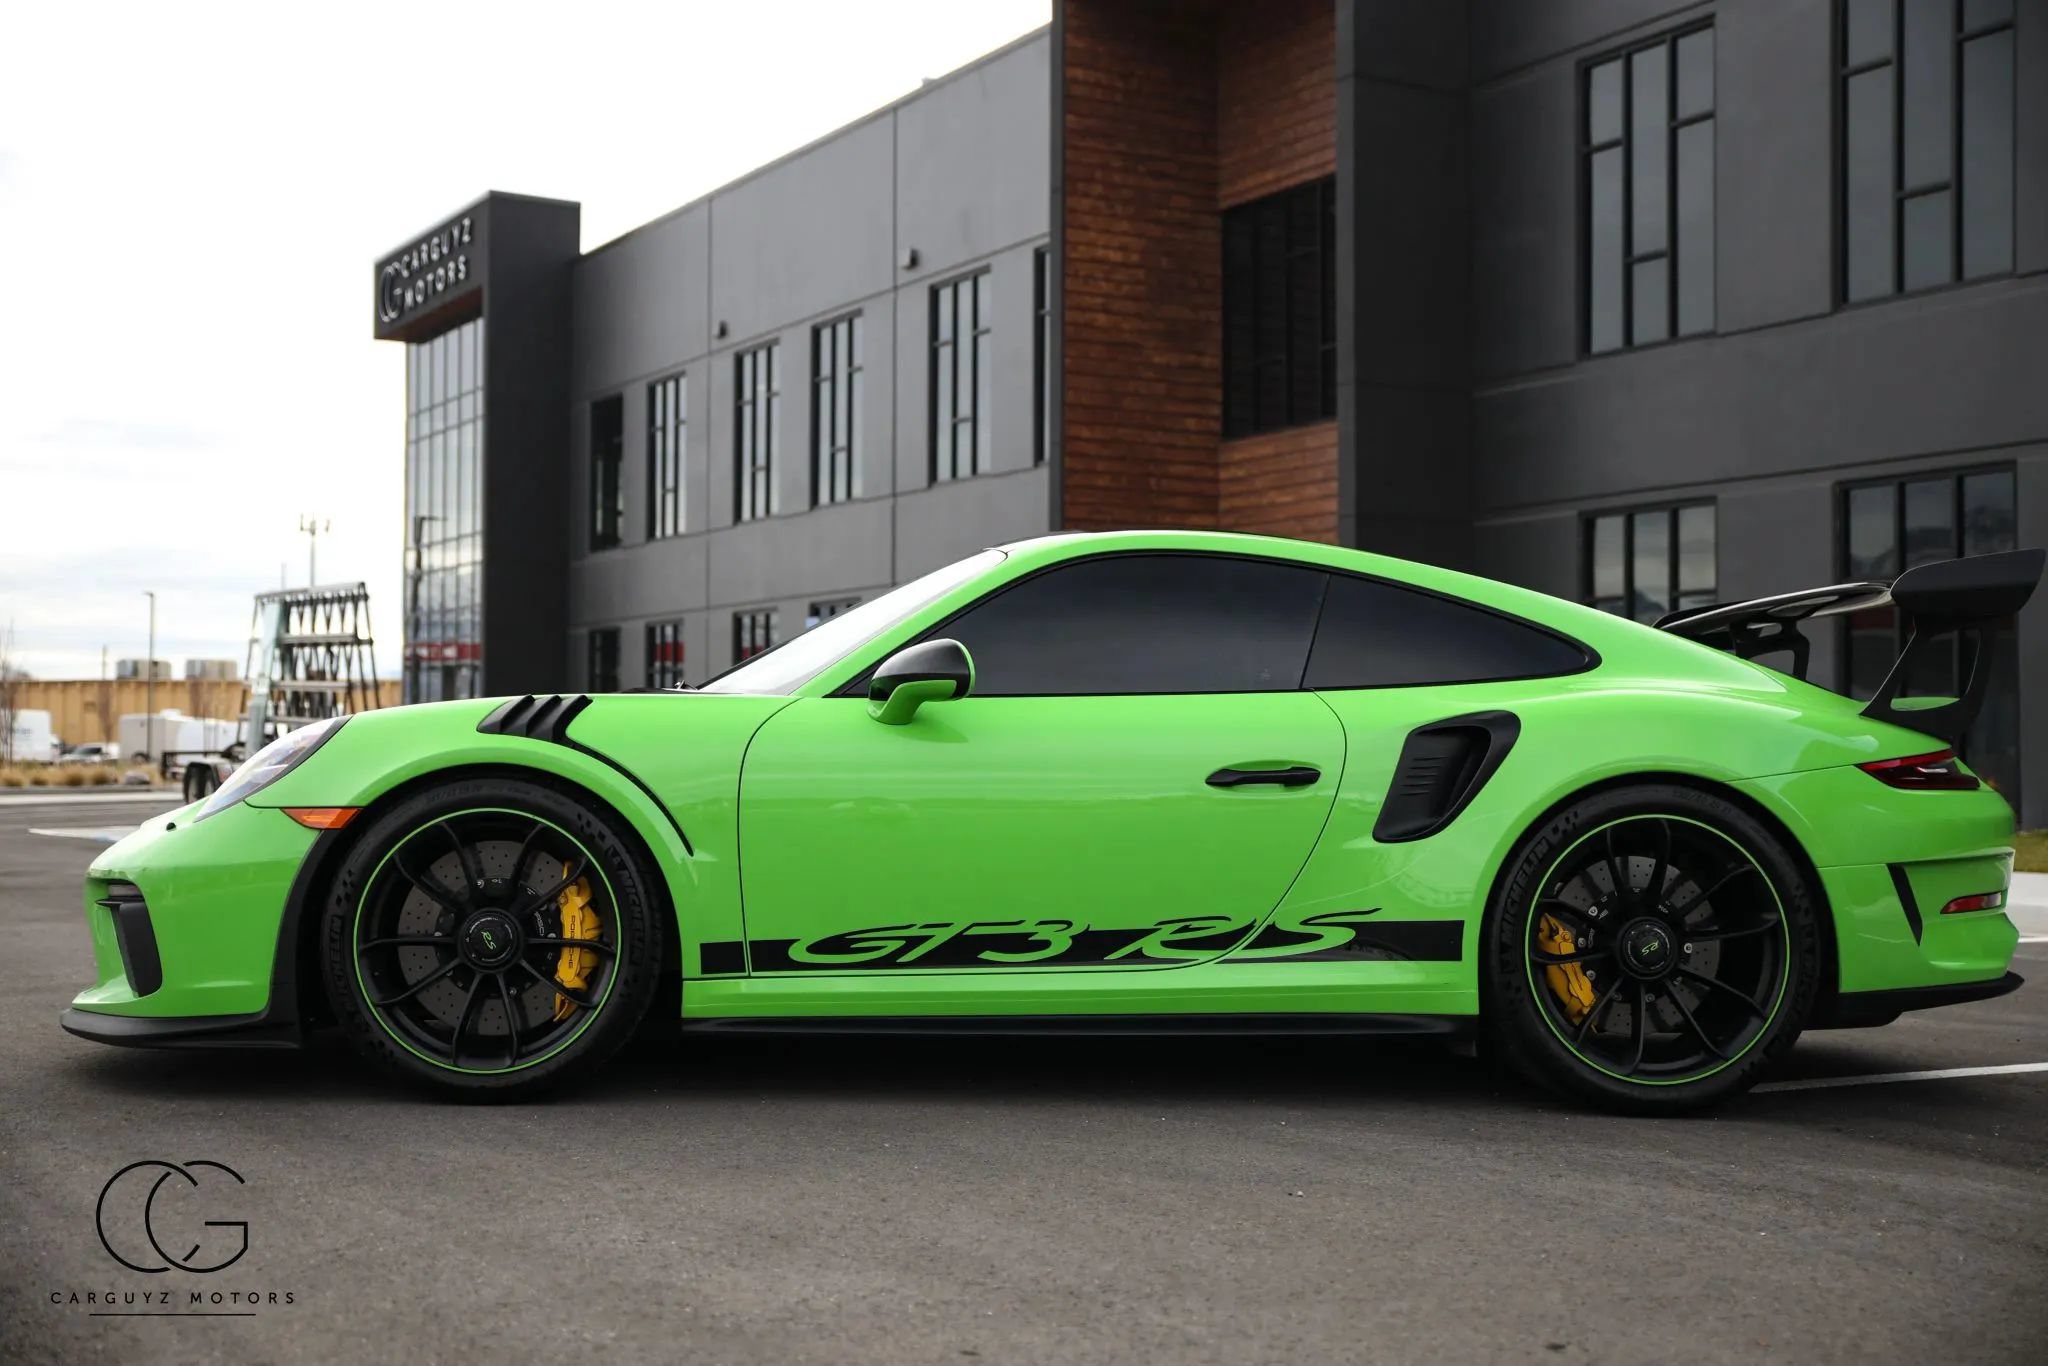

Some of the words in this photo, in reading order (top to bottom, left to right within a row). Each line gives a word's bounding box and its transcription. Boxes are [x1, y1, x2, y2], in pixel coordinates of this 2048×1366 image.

[401, 216, 472, 279] CARGUYZ
[404, 254, 467, 312] MOTORS
[788, 919, 1074, 964] GT3
[1103, 907, 1383, 960] RS
